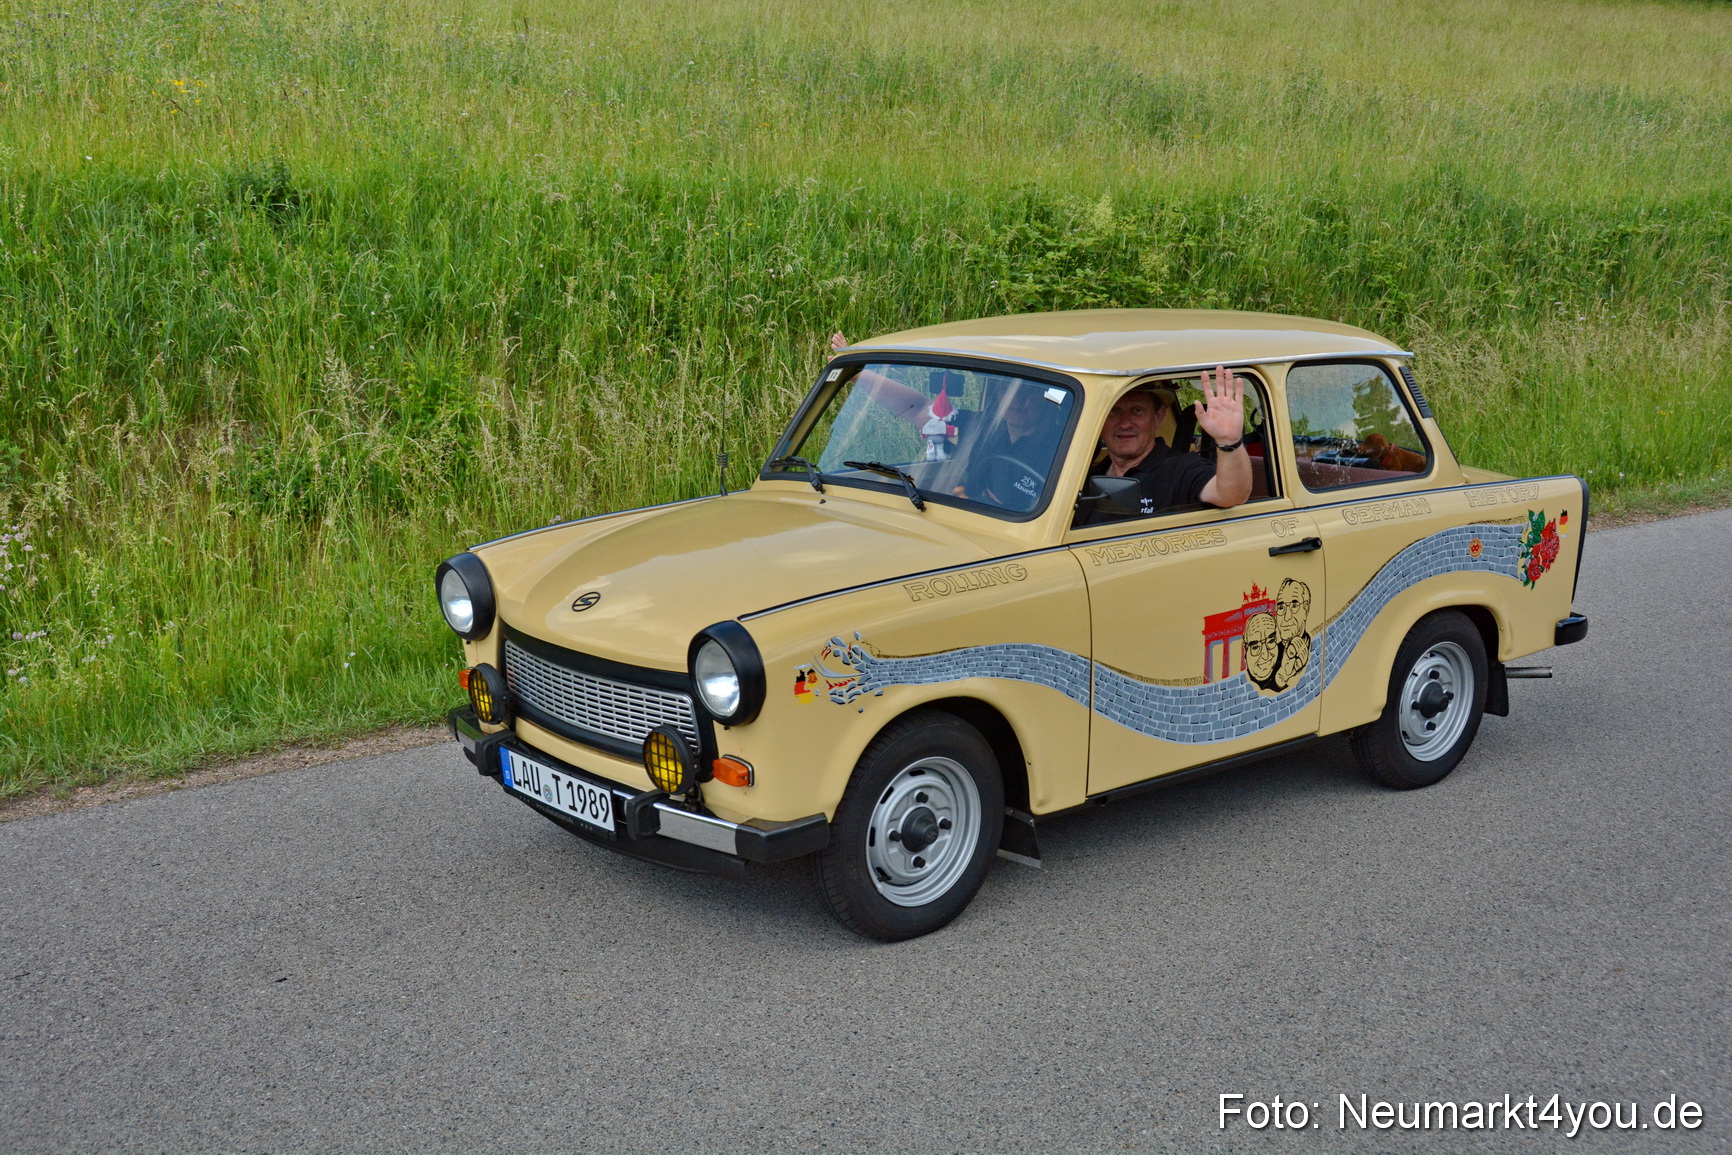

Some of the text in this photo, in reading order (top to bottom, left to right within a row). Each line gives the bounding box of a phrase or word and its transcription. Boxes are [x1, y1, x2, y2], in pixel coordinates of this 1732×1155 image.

[903, 483, 1540, 602] ROLLING MEMORIES OF GERMAN HISTORY
[510, 755, 542, 797] LAU
